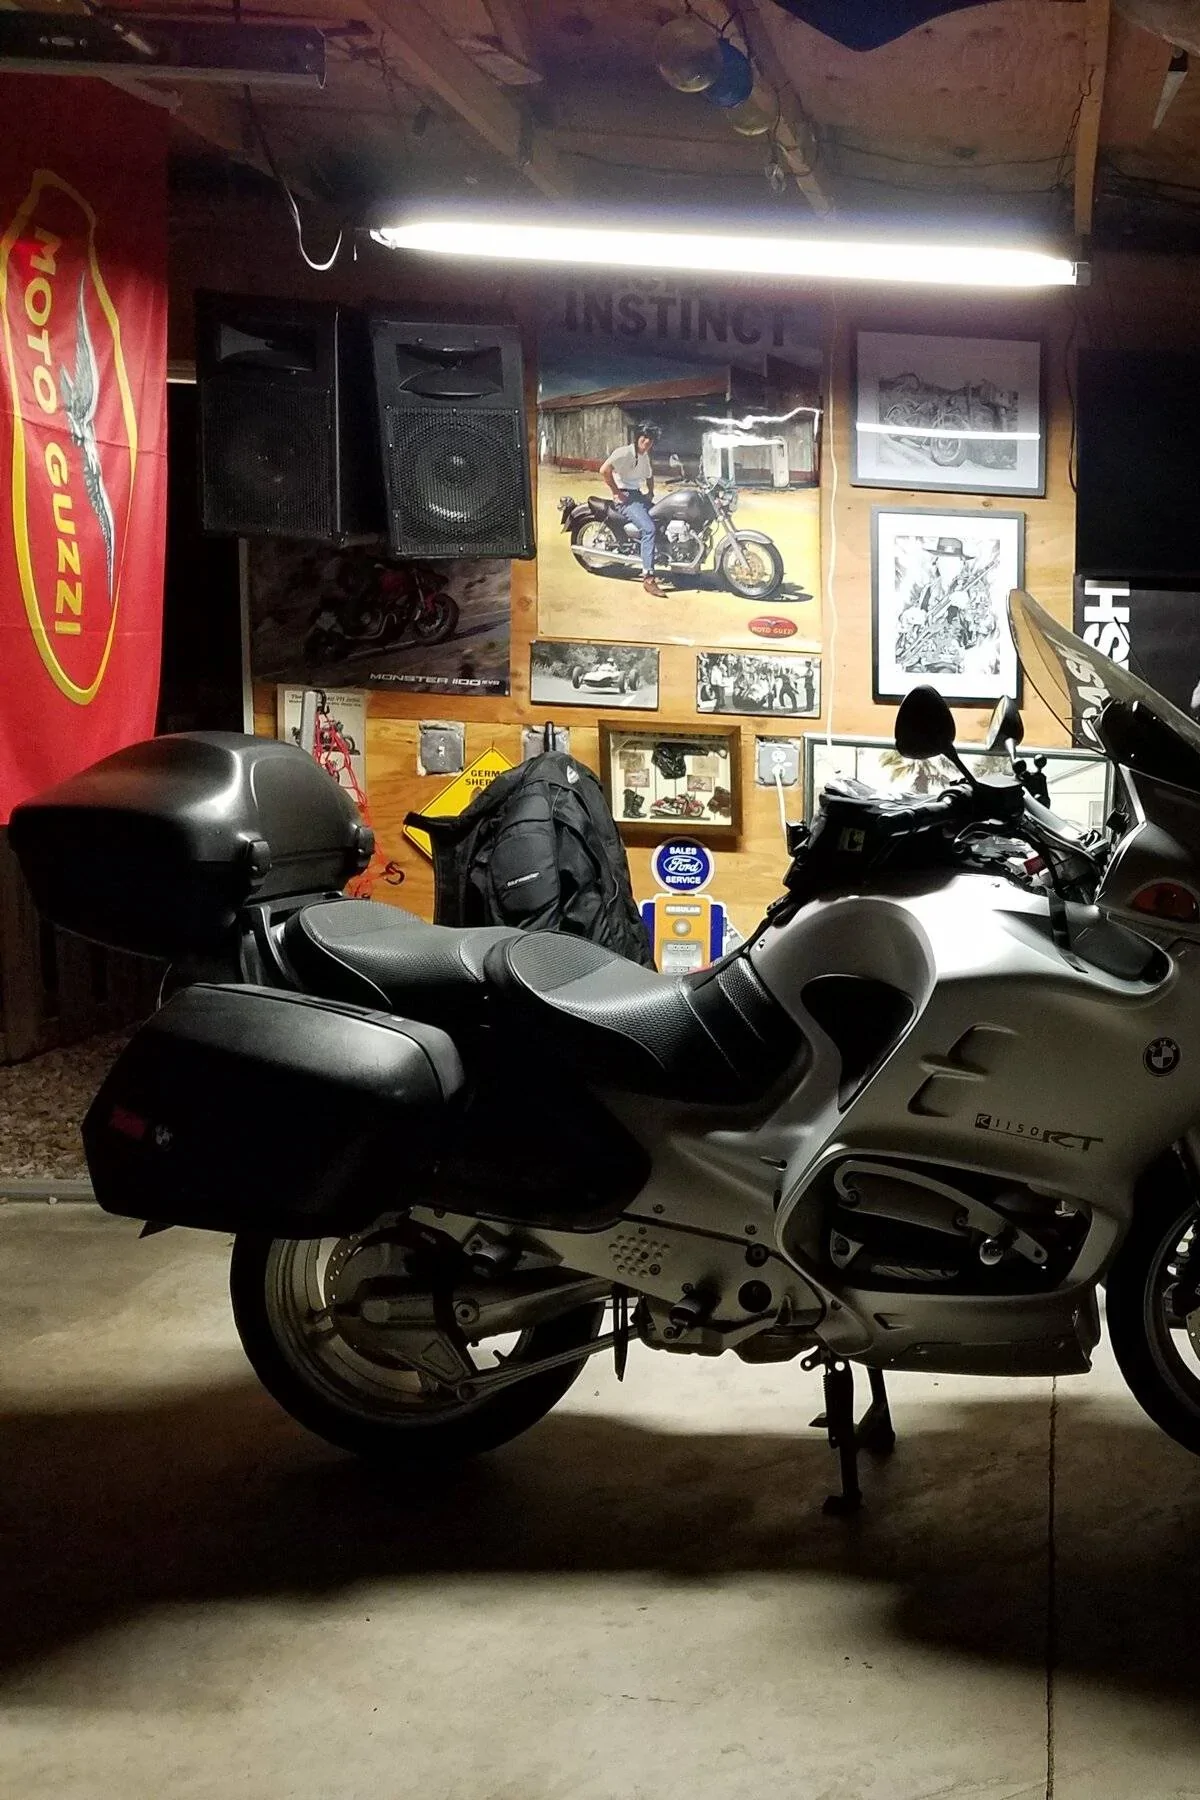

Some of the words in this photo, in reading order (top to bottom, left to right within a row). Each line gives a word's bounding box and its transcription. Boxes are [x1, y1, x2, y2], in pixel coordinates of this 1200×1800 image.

[564, 289, 794, 347] INSTINCT
[24, 225, 62, 416] MOTO
[43, 445, 83, 638] GUZZI
[369, 672, 449, 685] MONSTER
[669, 846, 698, 856] SALES
[667, 857, 701, 873] Ford
[664, 875, 702, 885] SERVICE
